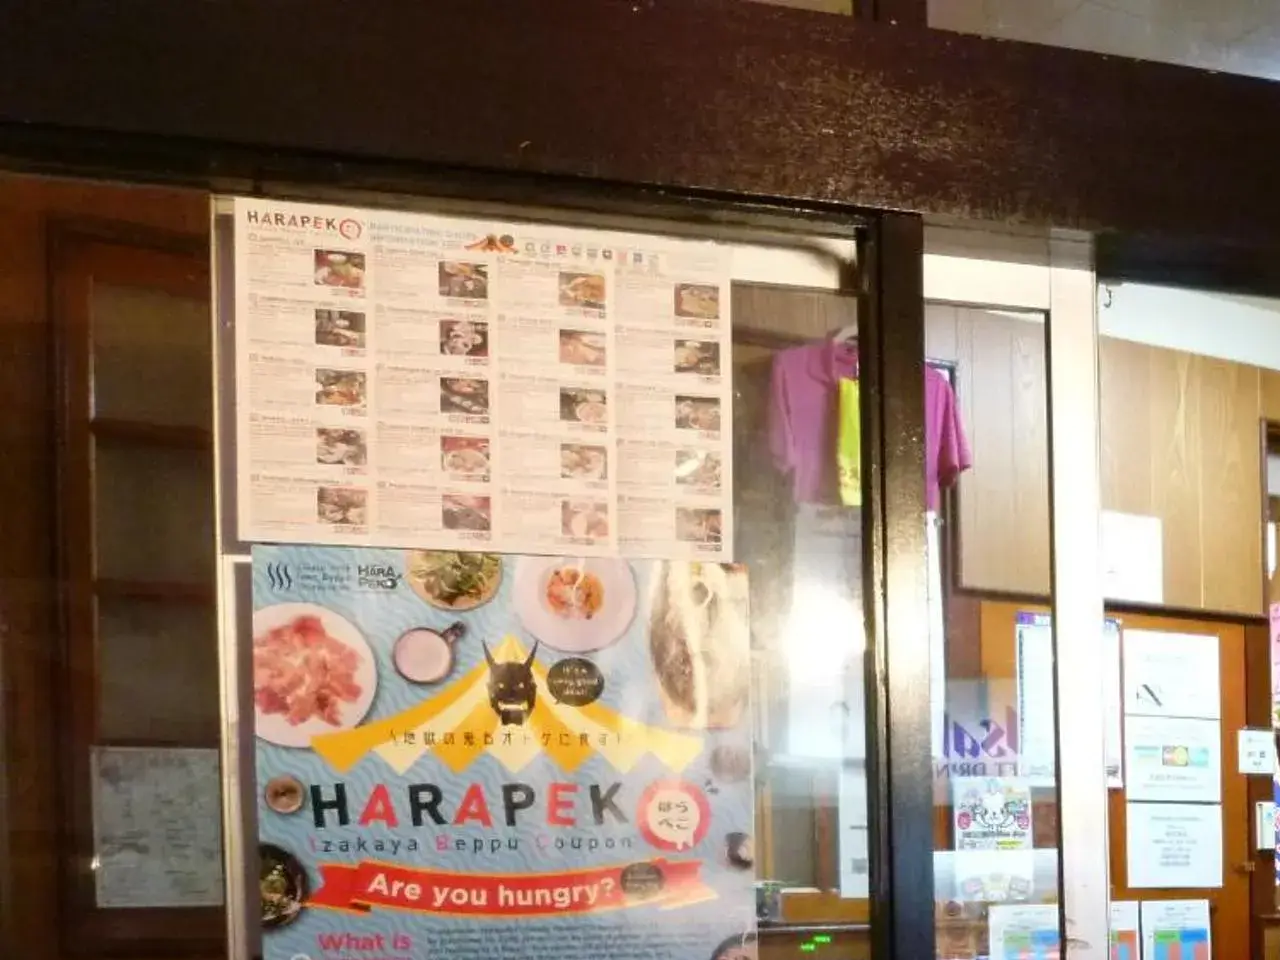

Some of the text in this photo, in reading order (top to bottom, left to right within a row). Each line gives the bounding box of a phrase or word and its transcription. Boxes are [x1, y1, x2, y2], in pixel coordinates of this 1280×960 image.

[309, 833, 634, 853] Izakaya Beppu Coupon
[367, 872, 422, 898] Are
[432, 883, 488, 910] you
[497, 876, 617, 910] hungry?
[318, 932, 412, 952] What is
